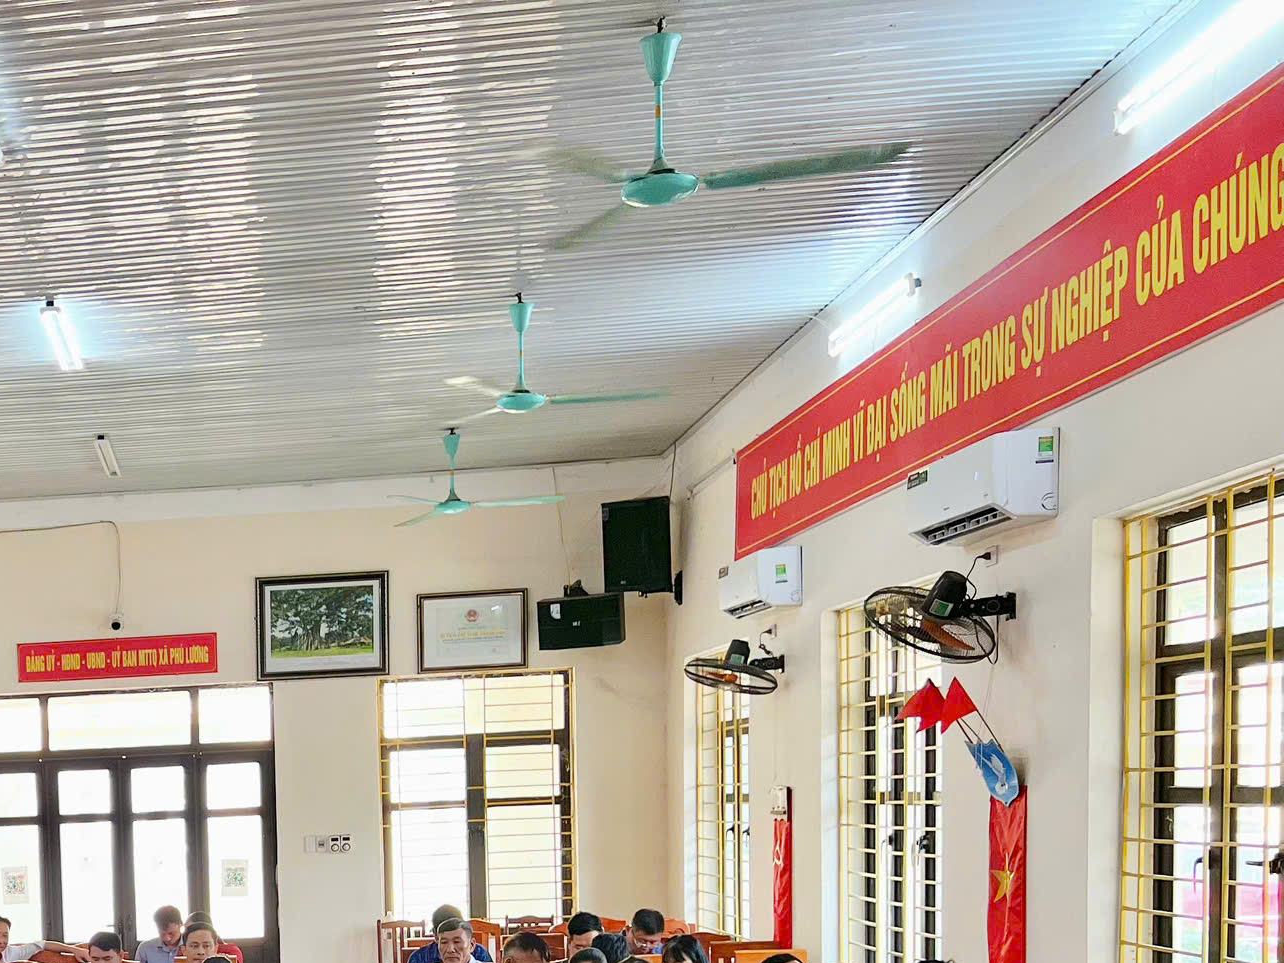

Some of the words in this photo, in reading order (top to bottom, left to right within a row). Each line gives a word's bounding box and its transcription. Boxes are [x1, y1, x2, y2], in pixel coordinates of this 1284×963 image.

[751, 457, 767, 520] CHỦ
[769, 458, 788, 519] TỊCH
[789, 433, 802, 499] HỒ
[804, 426, 820, 491] CHÍ
[822, 418, 850, 480] MINH
[853, 399, 865, 463] VĨ
[867, 395, 887, 462] ĐẠI
[890, 361, 926, 442] SỐNG
[930, 342, 958, 421] MÃI
[962, 315, 1016, 402] TRONG
[1021, 286, 1048, 377] SỰ
[1051, 239, 1128, 354] NGHIỆP
[1136, 194, 1185, 306] CỦA
[1192, 142, 1284, 274] CHÚNG
[86, 651, 106, 670] UBND
[122, 651, 138, 668] BAN
[139, 649, 157, 667] MTTQ
[158, 645, 169, 665] XÃ
[170, 643, 185, 665] PHÚ
[185, 645, 209, 664] LƯƠNG
